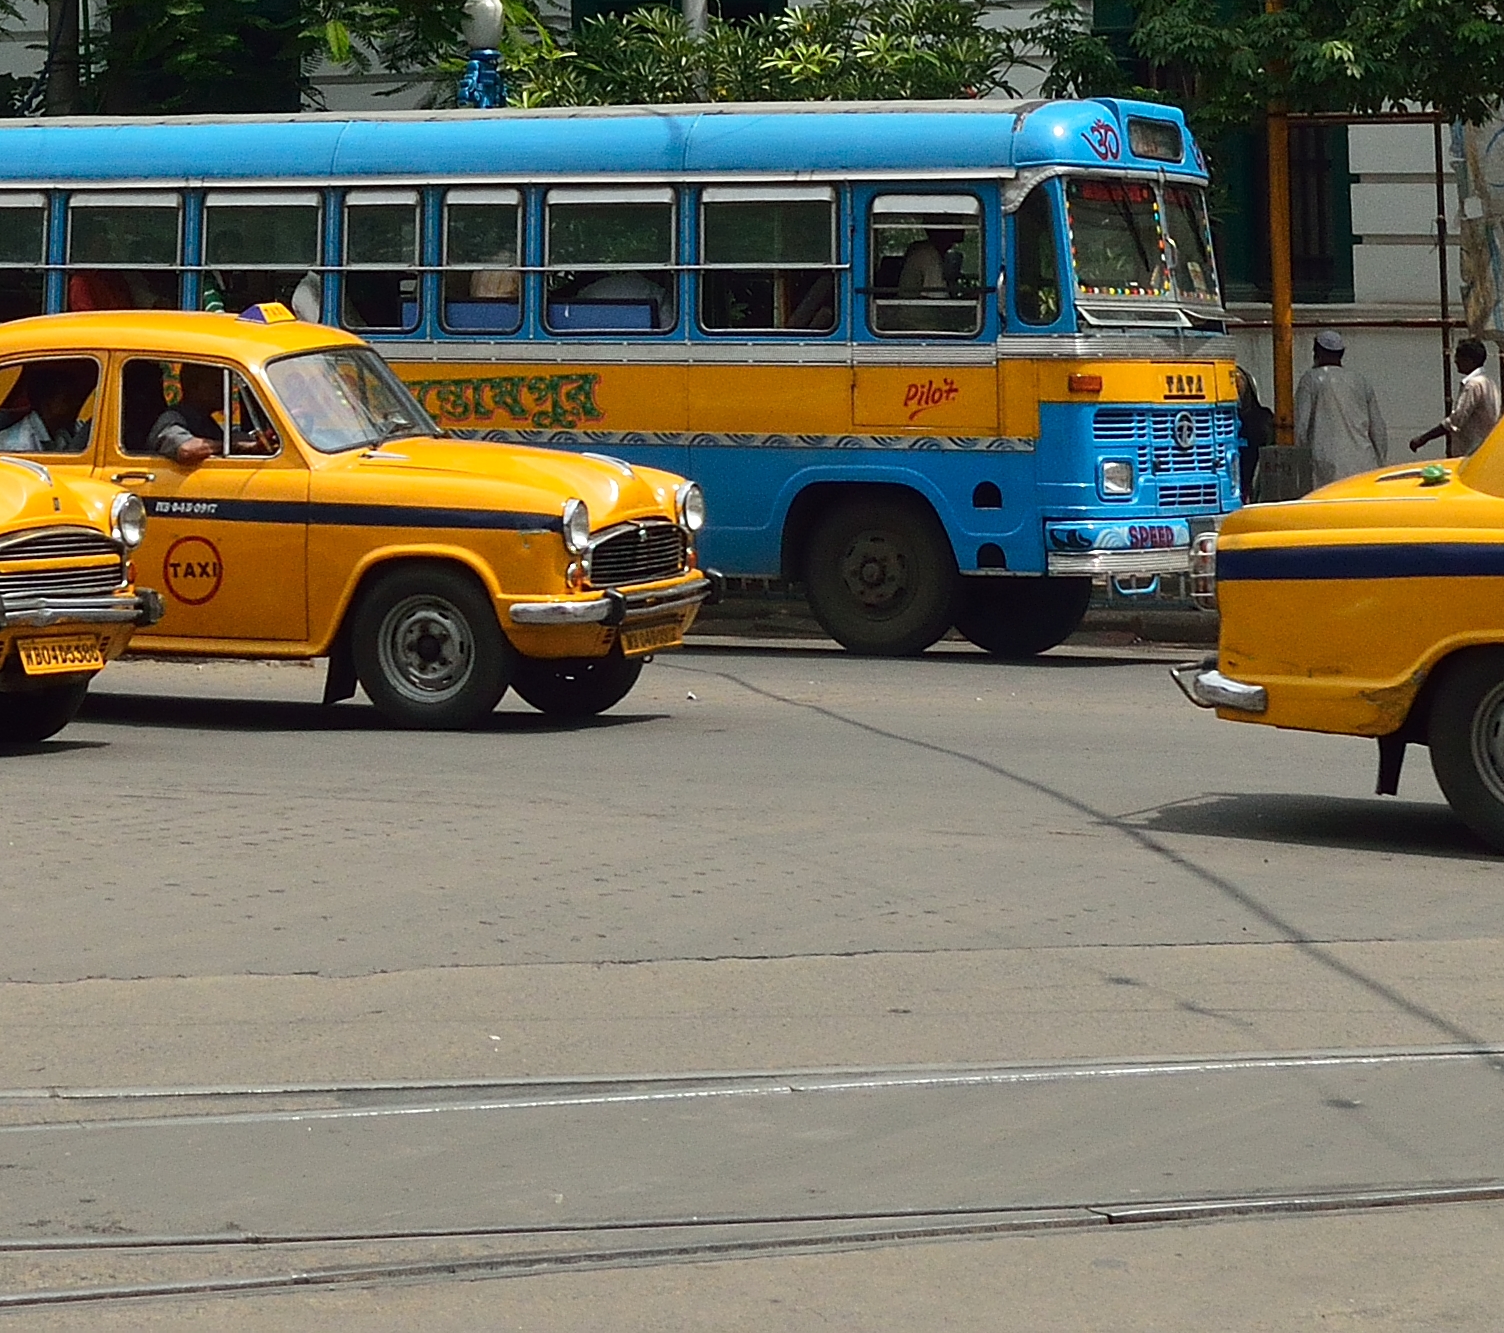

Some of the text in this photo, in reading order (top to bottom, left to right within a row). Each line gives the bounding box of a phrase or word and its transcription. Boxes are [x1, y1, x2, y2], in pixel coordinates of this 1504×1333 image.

[903, 378, 959, 407] Pilot
[1165, 374, 1204, 394] TATA
[1128, 525, 1175, 549] SPEED
[169, 562, 218, 579] TAXI
